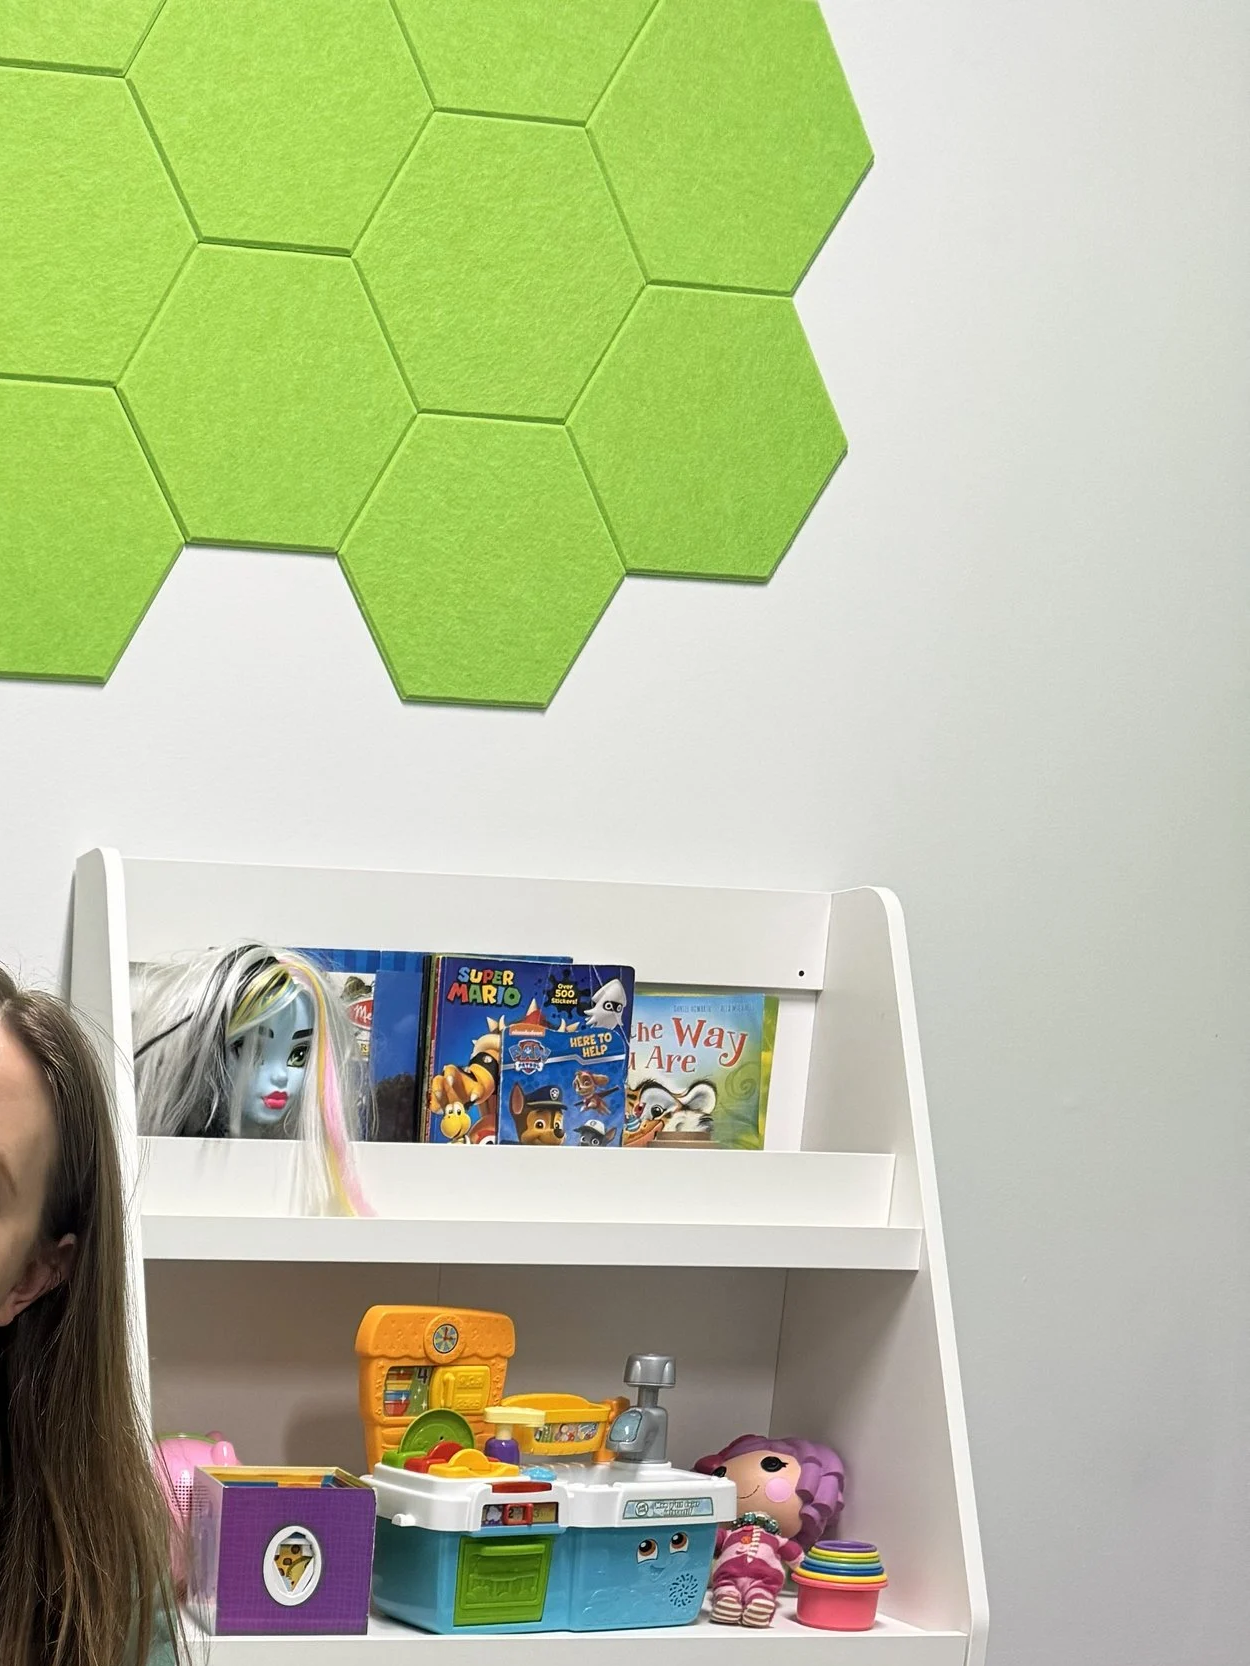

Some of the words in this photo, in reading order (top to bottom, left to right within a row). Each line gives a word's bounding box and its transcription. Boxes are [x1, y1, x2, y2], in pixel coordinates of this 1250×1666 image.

[457, 966, 515, 986] SUPER
[447, 982, 522, 1007] MARIO
[554, 989, 576, 998] 500
[569, 1034, 597, 1048] HERE
[597, 1032, 613, 1043] TO
[671, 1017, 748, 1067] Way
[582, 1045, 608, 1058] HELP
[645, 1045, 696, 1073] Are
